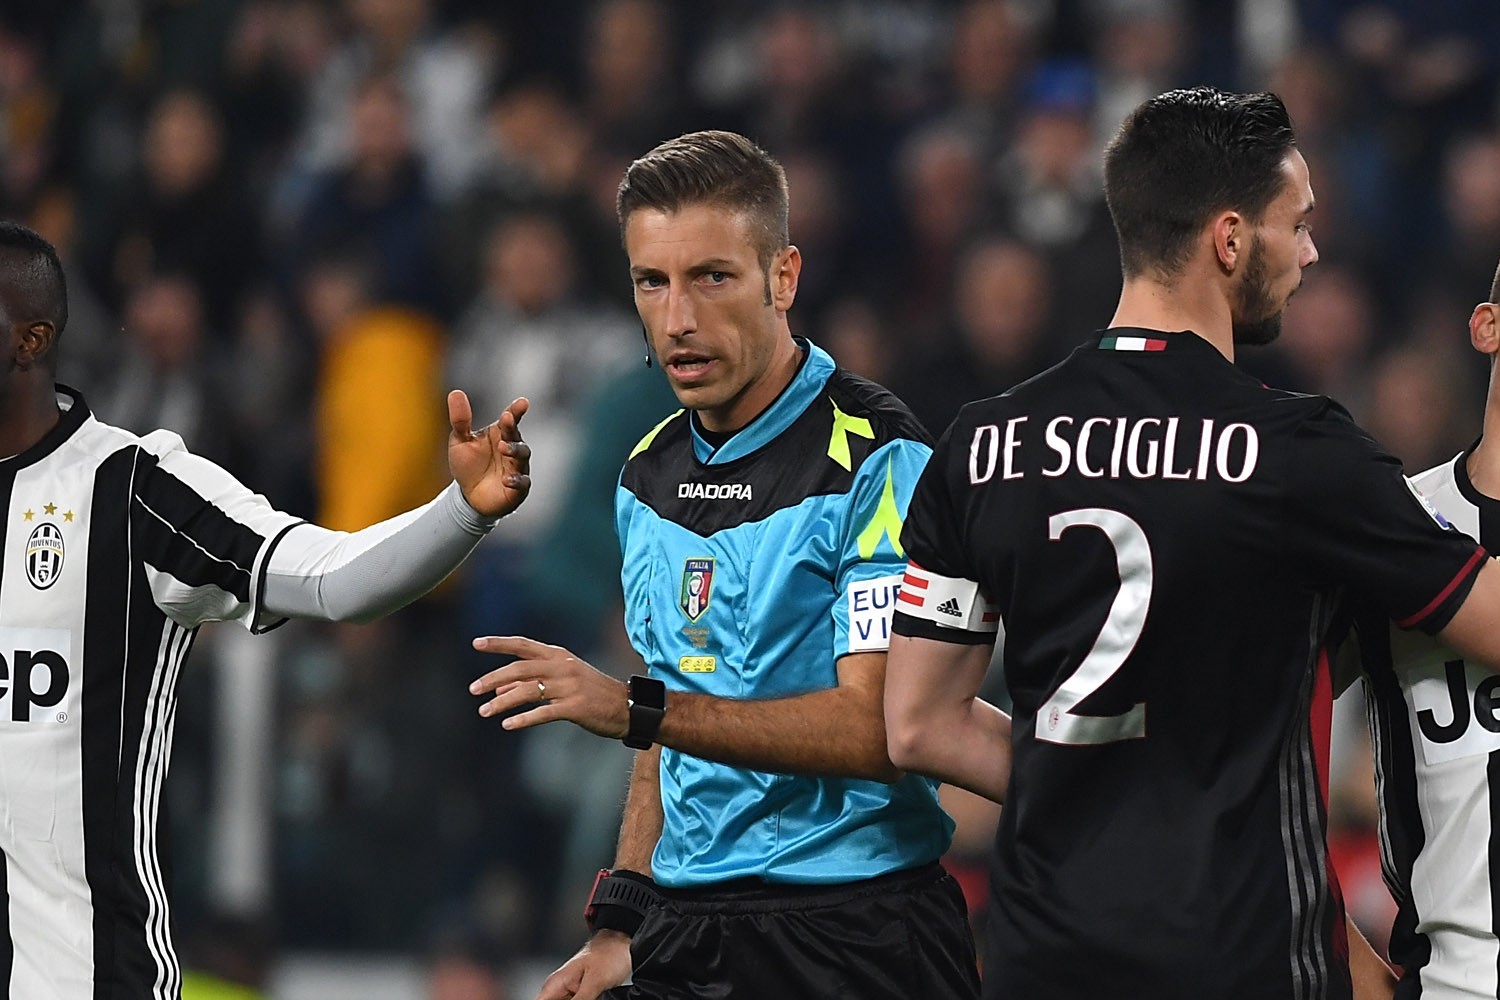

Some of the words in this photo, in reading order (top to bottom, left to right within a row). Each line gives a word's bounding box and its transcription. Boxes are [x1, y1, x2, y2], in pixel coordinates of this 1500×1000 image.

[968, 416, 1029, 485] DE
[1041, 416, 1259, 483] SCIGLIO
[677, 483, 752, 501] DIADORA
[30, 538, 61, 550] JUVENTUS
[689, 561, 709, 570] ITALIA
[936, 605, 962, 618] adidas
[1034, 507, 1154, 745] 2
